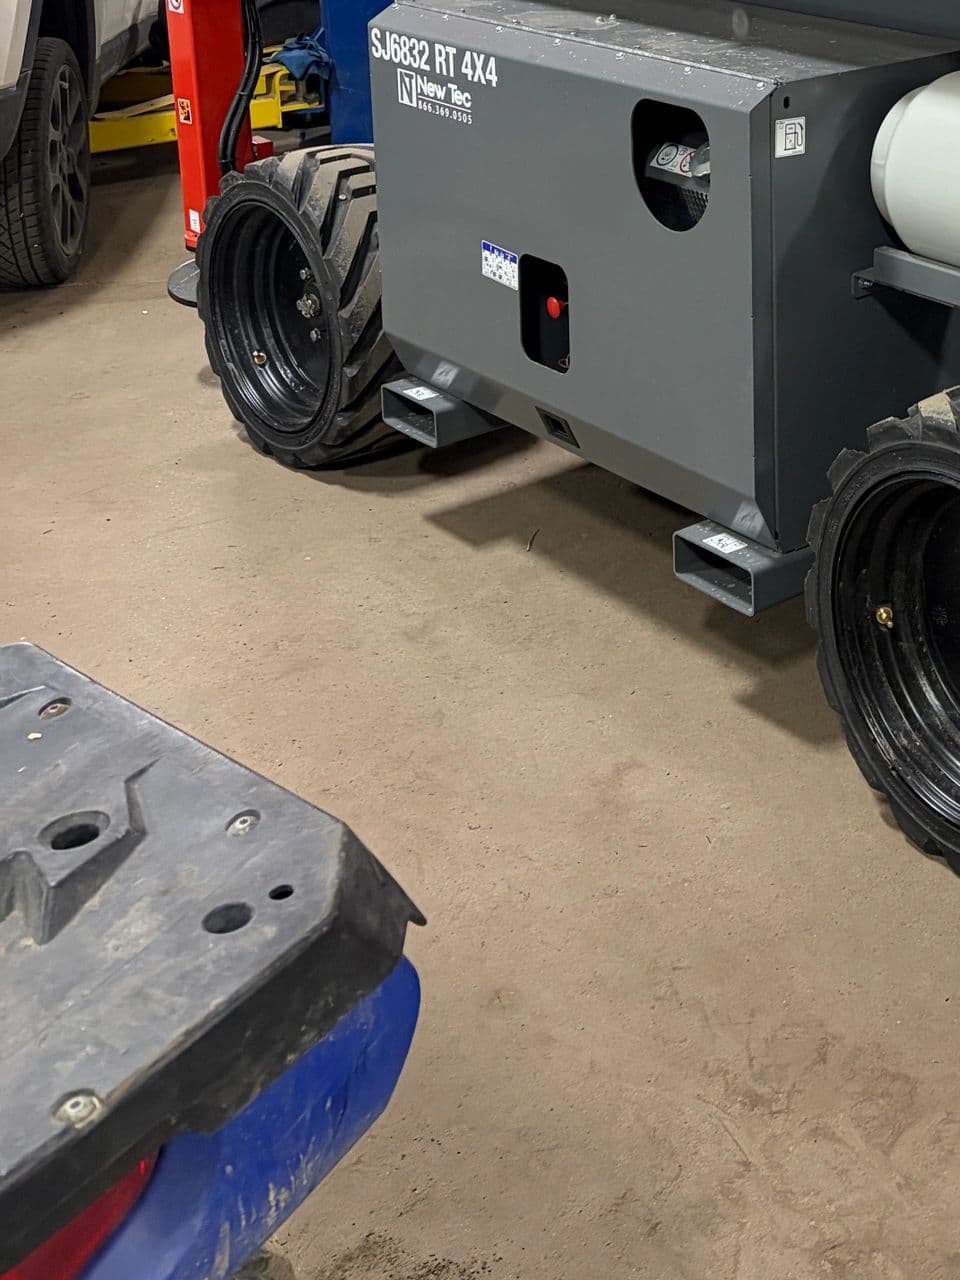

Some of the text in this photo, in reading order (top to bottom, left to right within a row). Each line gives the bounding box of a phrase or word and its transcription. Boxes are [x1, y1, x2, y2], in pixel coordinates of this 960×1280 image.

[371, 27, 498, 87] SJ6832 RT 4X4
[417, 74, 472, 108] New Tec
[418, 100, 473, 125] 866.369.0505
